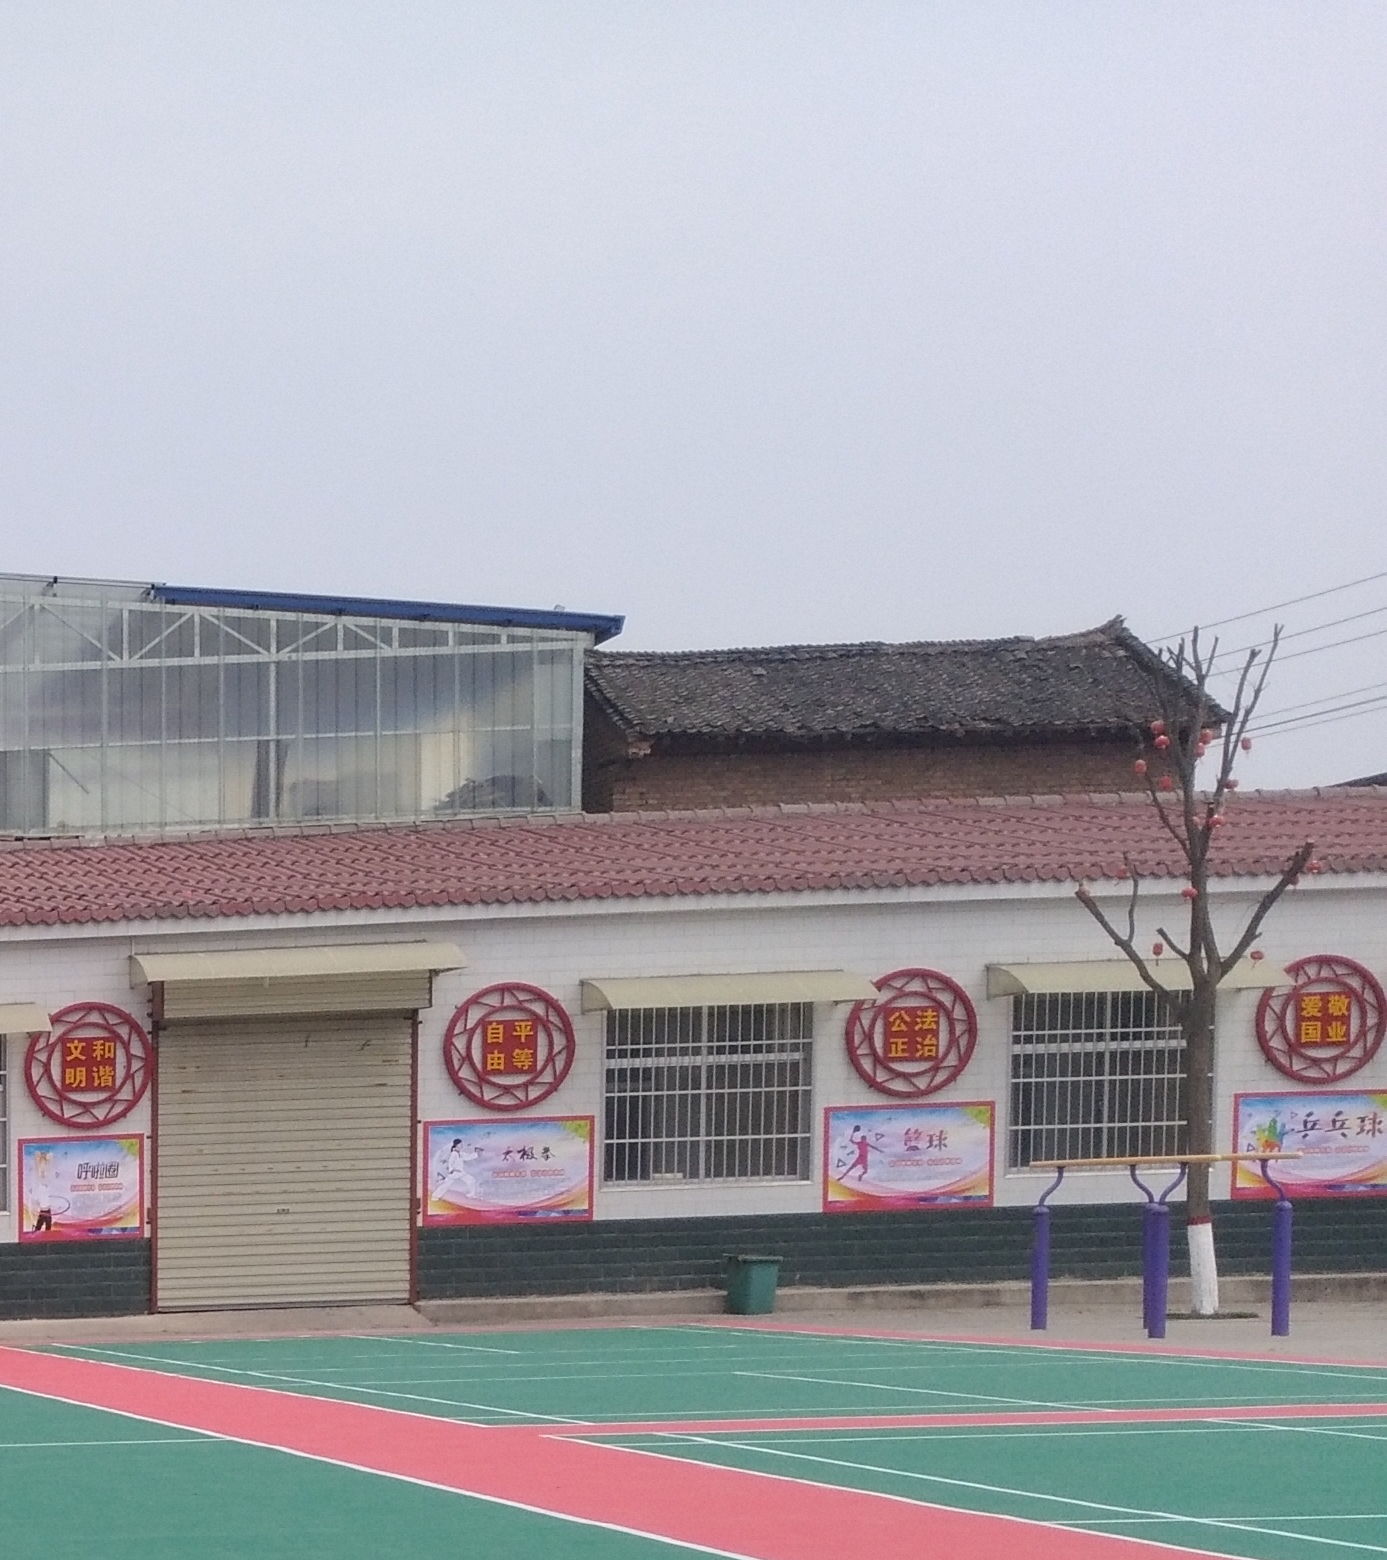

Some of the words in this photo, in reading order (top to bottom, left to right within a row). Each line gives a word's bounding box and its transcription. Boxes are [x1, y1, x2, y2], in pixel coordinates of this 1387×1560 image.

[887, 1010, 910, 1059] 公正
[914, 1008, 938, 1059] 法治
[1300, 995, 1322, 1043] 爱国
[1326, 994, 1349, 1042] 敬业
[65, 1038, 88, 1087] 文明
[92, 1039, 116, 1088] 和谐
[485, 1021, 506, 1072] 自由
[512, 1019, 534, 1070] 平等
[903, 1127, 948, 1151] 篮球
[1295, 1110, 1384, 1139] 乒乓球
[77, 1161, 120, 1180] 呼啦圈
[502, 1145, 556, 1162] 太极拳
